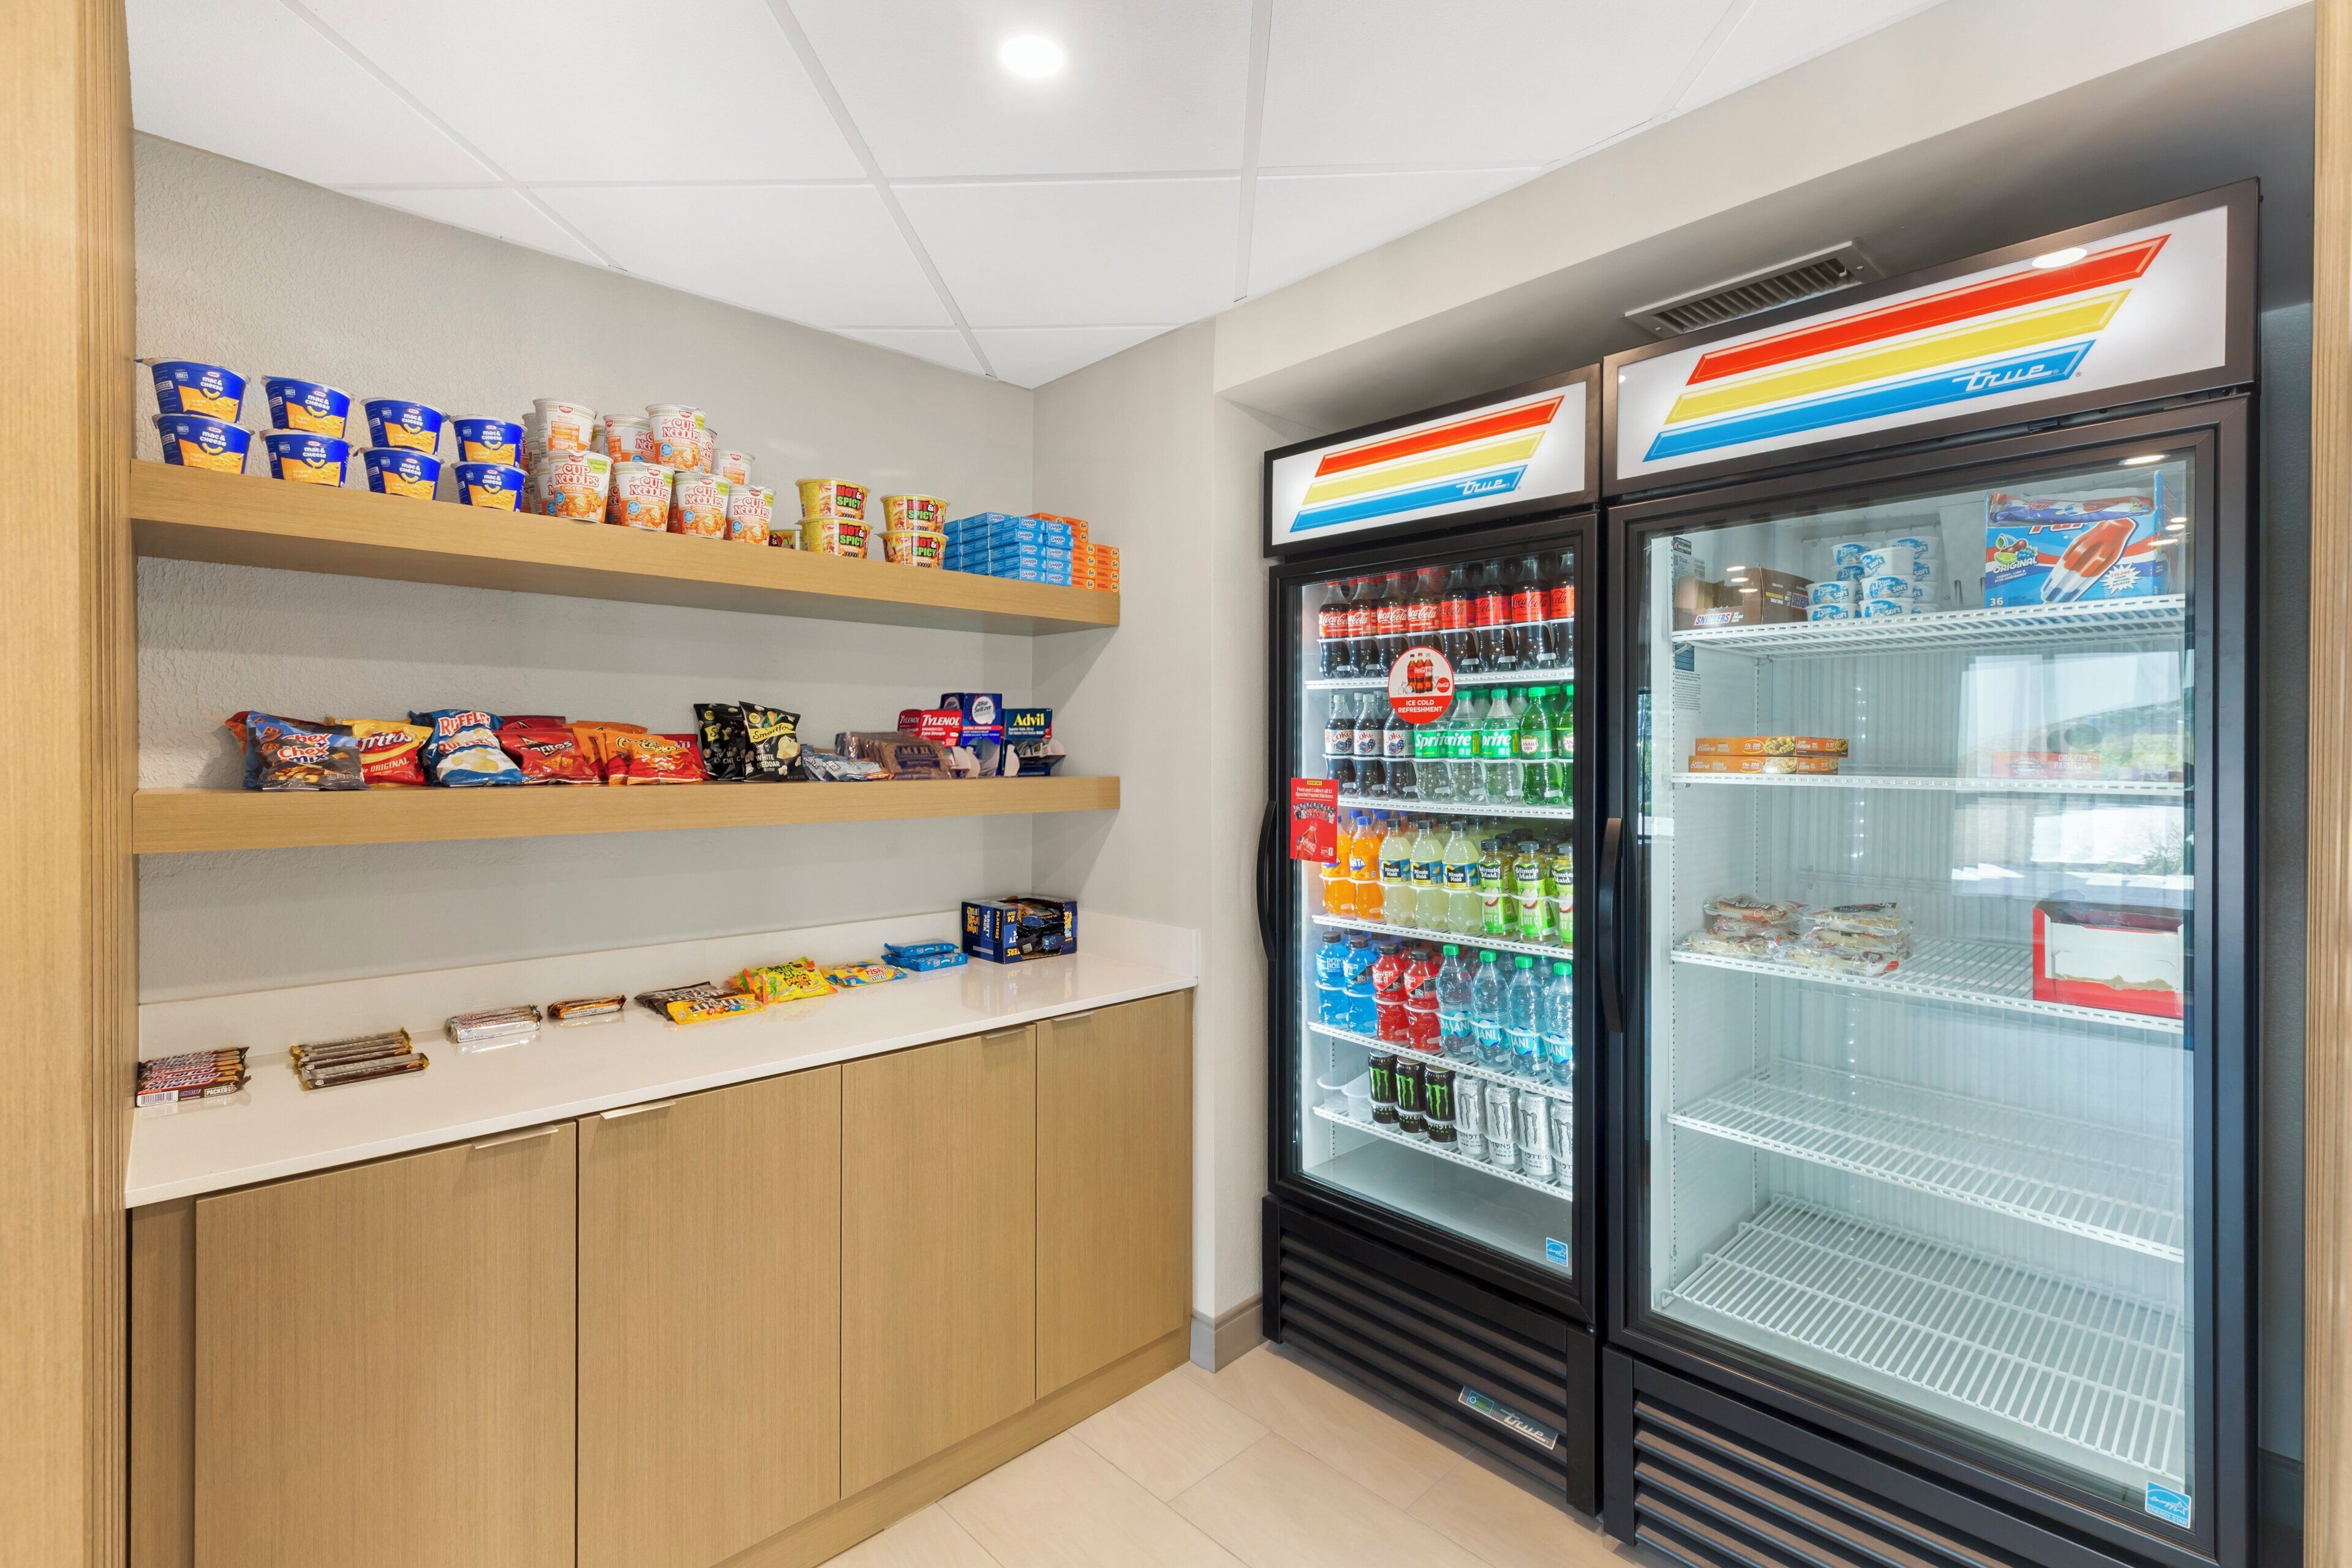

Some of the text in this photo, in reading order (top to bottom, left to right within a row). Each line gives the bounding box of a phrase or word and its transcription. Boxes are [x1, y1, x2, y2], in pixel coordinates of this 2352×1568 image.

[1953, 363, 2051, 394] true
[672, 420, 696, 430] CUP
[662, 428, 701, 442] NOODLES
[563, 464, 590, 475] CUP
[556, 473, 599, 488] NOODLES
[640, 477, 665, 488] CUP
[630, 484, 669, 500] NOODLES
[693, 486, 718, 497] CUP
[837, 485, 858, 497] HOT
[1455, 479, 1507, 495] true
[685, 494, 723, 508] NOODLES
[742, 497, 765, 507] CUP
[837, 496, 861, 509] SPICY
[907, 499, 934, 512] HOT &
[734, 505, 769, 519] NOODLES
[908, 509, 934, 521] SPICY
[839, 523, 859, 535] HOT
[839, 534, 864, 546] SPICY
[911, 535, 932, 547] HOT
[912, 546, 936, 557] SPICY
[1993, 557, 2037, 574] ORIGINAL
[1989, 597, 2004, 606] 36
[1695, 613, 1730, 625] SNICKERS
[922, 715, 960, 726] TYLENOL
[1013, 713, 1044, 726] Advil
[277, 745, 330, 758] Chex
[371, 757, 408, 772] ORIGINAL
[206, 1087, 227, 1095] PACKED
[2148, 1506, 2187, 1526] ENERGY STAR
